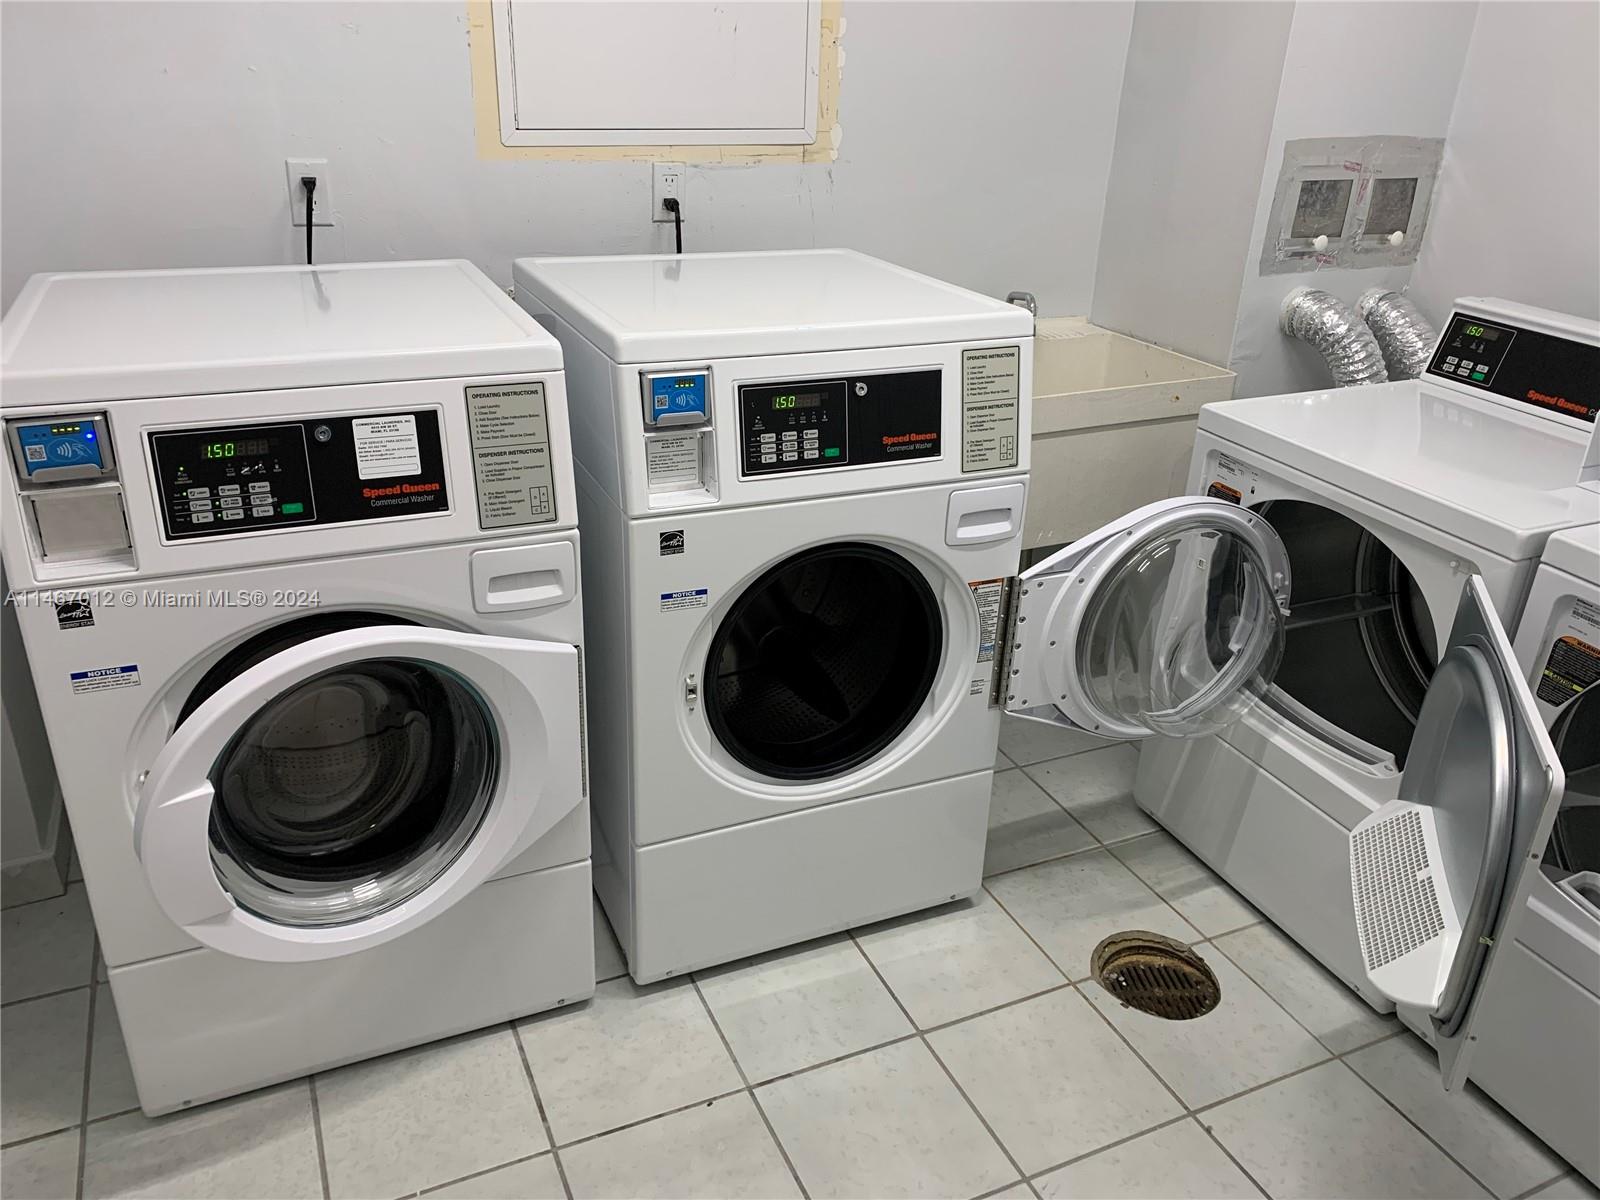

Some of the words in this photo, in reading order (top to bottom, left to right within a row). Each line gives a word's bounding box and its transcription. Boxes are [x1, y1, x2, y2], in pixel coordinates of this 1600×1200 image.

[472, 391, 501, 399] OPERATING
[502, 389, 539, 397] INSTRUCTIONS
[1527, 389, 1557, 405] Speed
[1557, 398, 1588, 414] Queen
[882, 434, 909, 445] Speed
[910, 432, 937, 441] Queen
[208, 443, 235, 458] 1.50
[887, 444, 914, 452] Commercial
[915, 442, 932, 450] Washer
[479, 450, 508, 458] DISPENSER
[363, 485, 401, 498] Speed
[402, 482, 440, 494] Queen
[371, 496, 410, 507] Commercial
[411, 494, 435, 503] Washer
[88, 667, 123, 678] NOTICE
